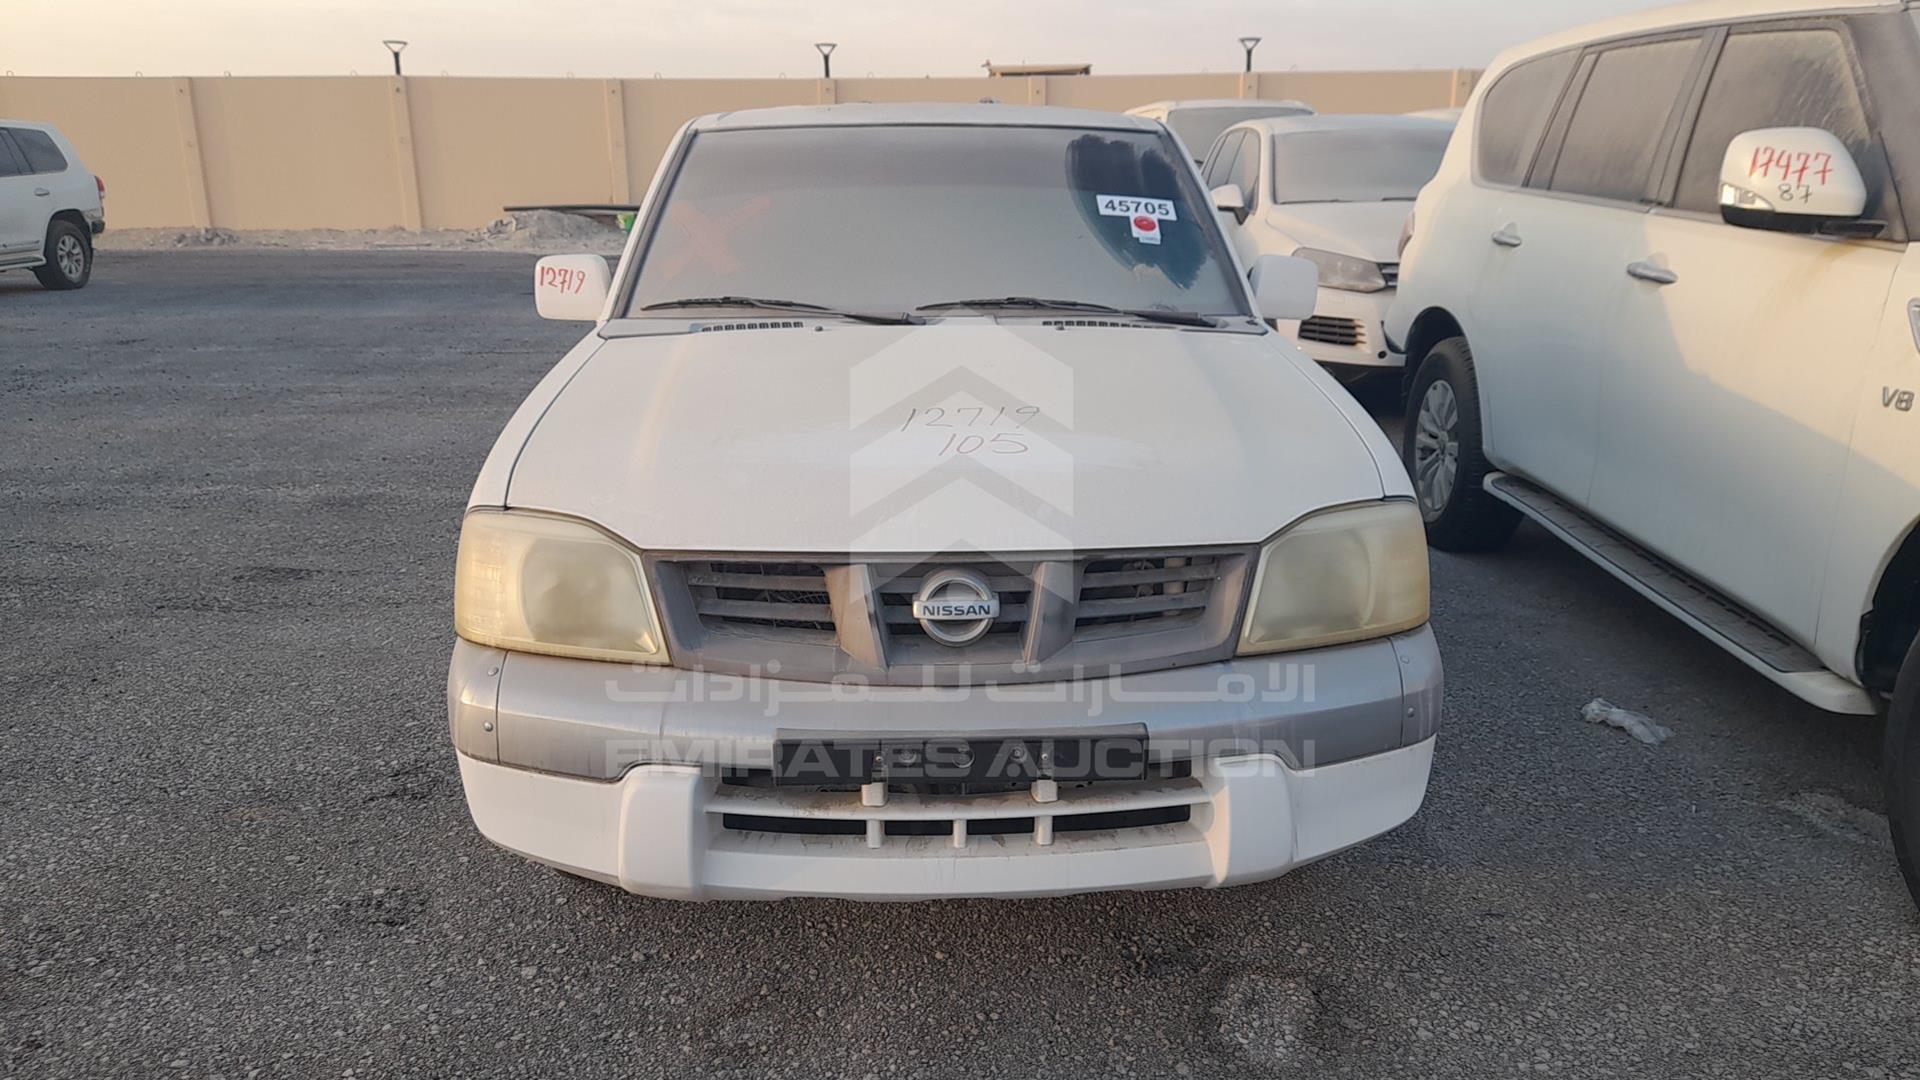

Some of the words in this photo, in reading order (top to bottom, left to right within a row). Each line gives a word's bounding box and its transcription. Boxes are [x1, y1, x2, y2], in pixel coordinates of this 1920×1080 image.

[1748, 146, 1833, 185] 17477
[1778, 183, 1813, 204] 87
[1104, 199, 1170, 216] 45705
[540, 266, 586, 294] 12719
[1882, 386, 1915, 412] V8
[900, 405, 1041, 432] 12719
[938, 433, 1029, 456] 105
[922, 604, 991, 616] NISSAN
